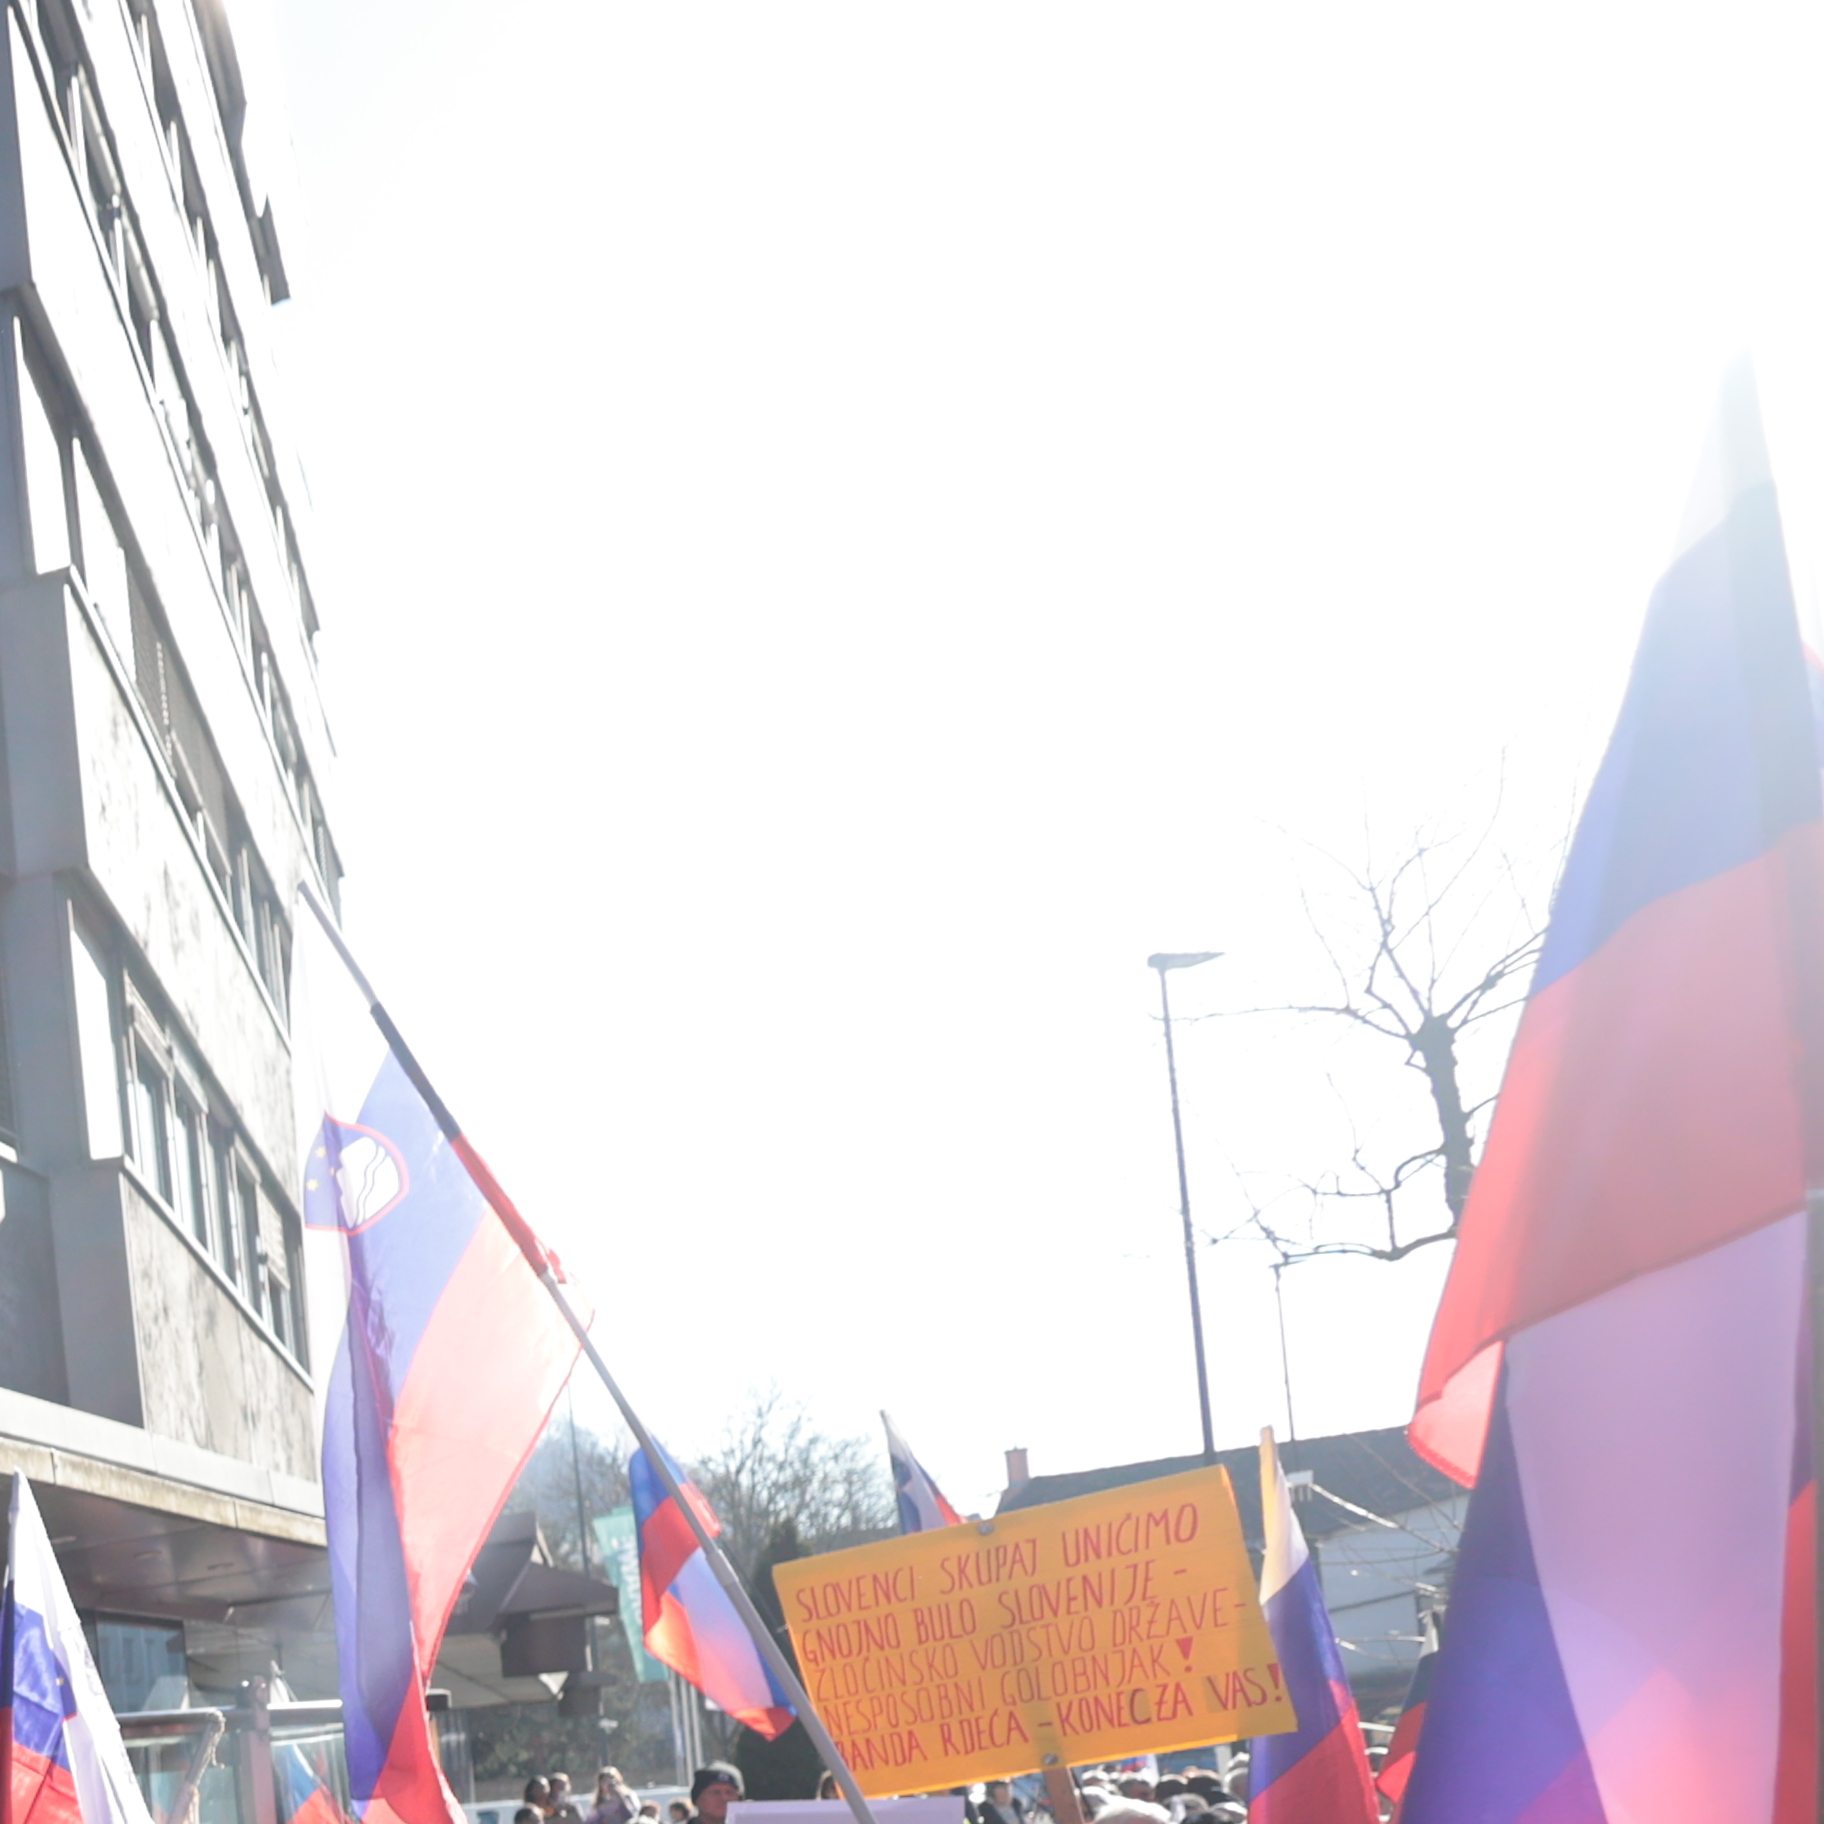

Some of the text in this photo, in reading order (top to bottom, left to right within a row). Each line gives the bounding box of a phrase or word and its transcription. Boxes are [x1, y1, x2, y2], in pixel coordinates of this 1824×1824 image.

[795, 1565, 916, 1623] SLOVENCI
[939, 1538, 1038, 1595] SKUPAJ
[801, 1612, 902, 1667] GNOJNO
[912, 1597, 978, 1646] BULO
[997, 1558, 1158, 1630] SLOVENIJE
[969, 1614, 1096, 1672] VODSTVO
[823, 1676, 987, 1738] NESPOSOBNI
